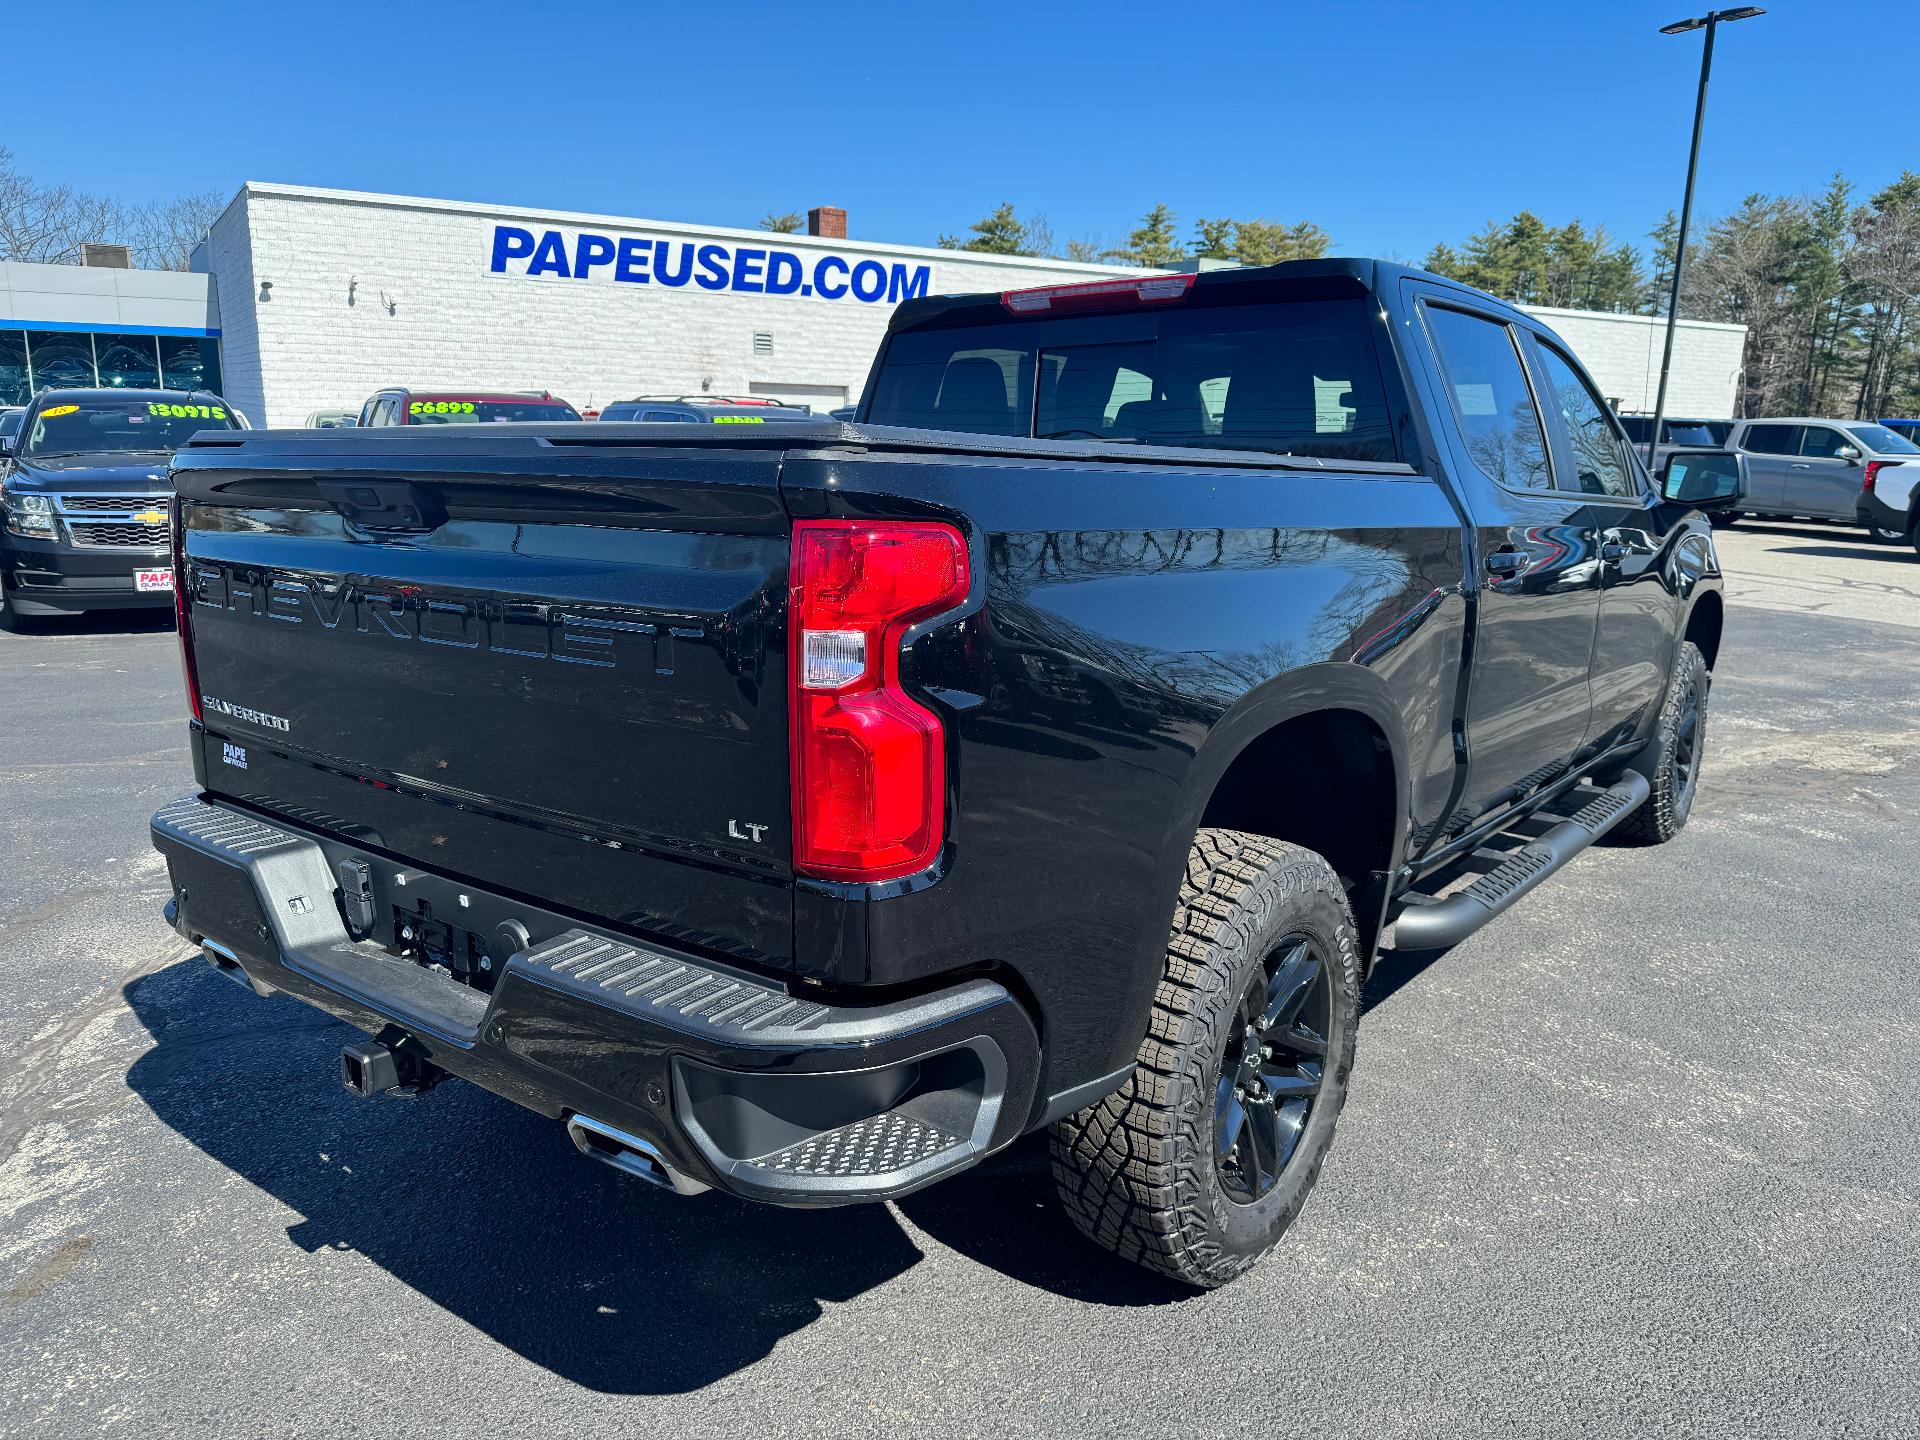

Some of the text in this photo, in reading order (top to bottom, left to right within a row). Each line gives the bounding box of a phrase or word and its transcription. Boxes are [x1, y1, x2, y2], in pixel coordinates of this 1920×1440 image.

[491, 225, 931, 303] PAPEUSED.COM
[409, 401, 475, 415] 56899
[193, 565, 706, 676] CHEVROLET
[202, 695, 289, 732] SILVERADO
[223, 742, 246, 762] PAPE
[728, 819, 769, 842] LT
